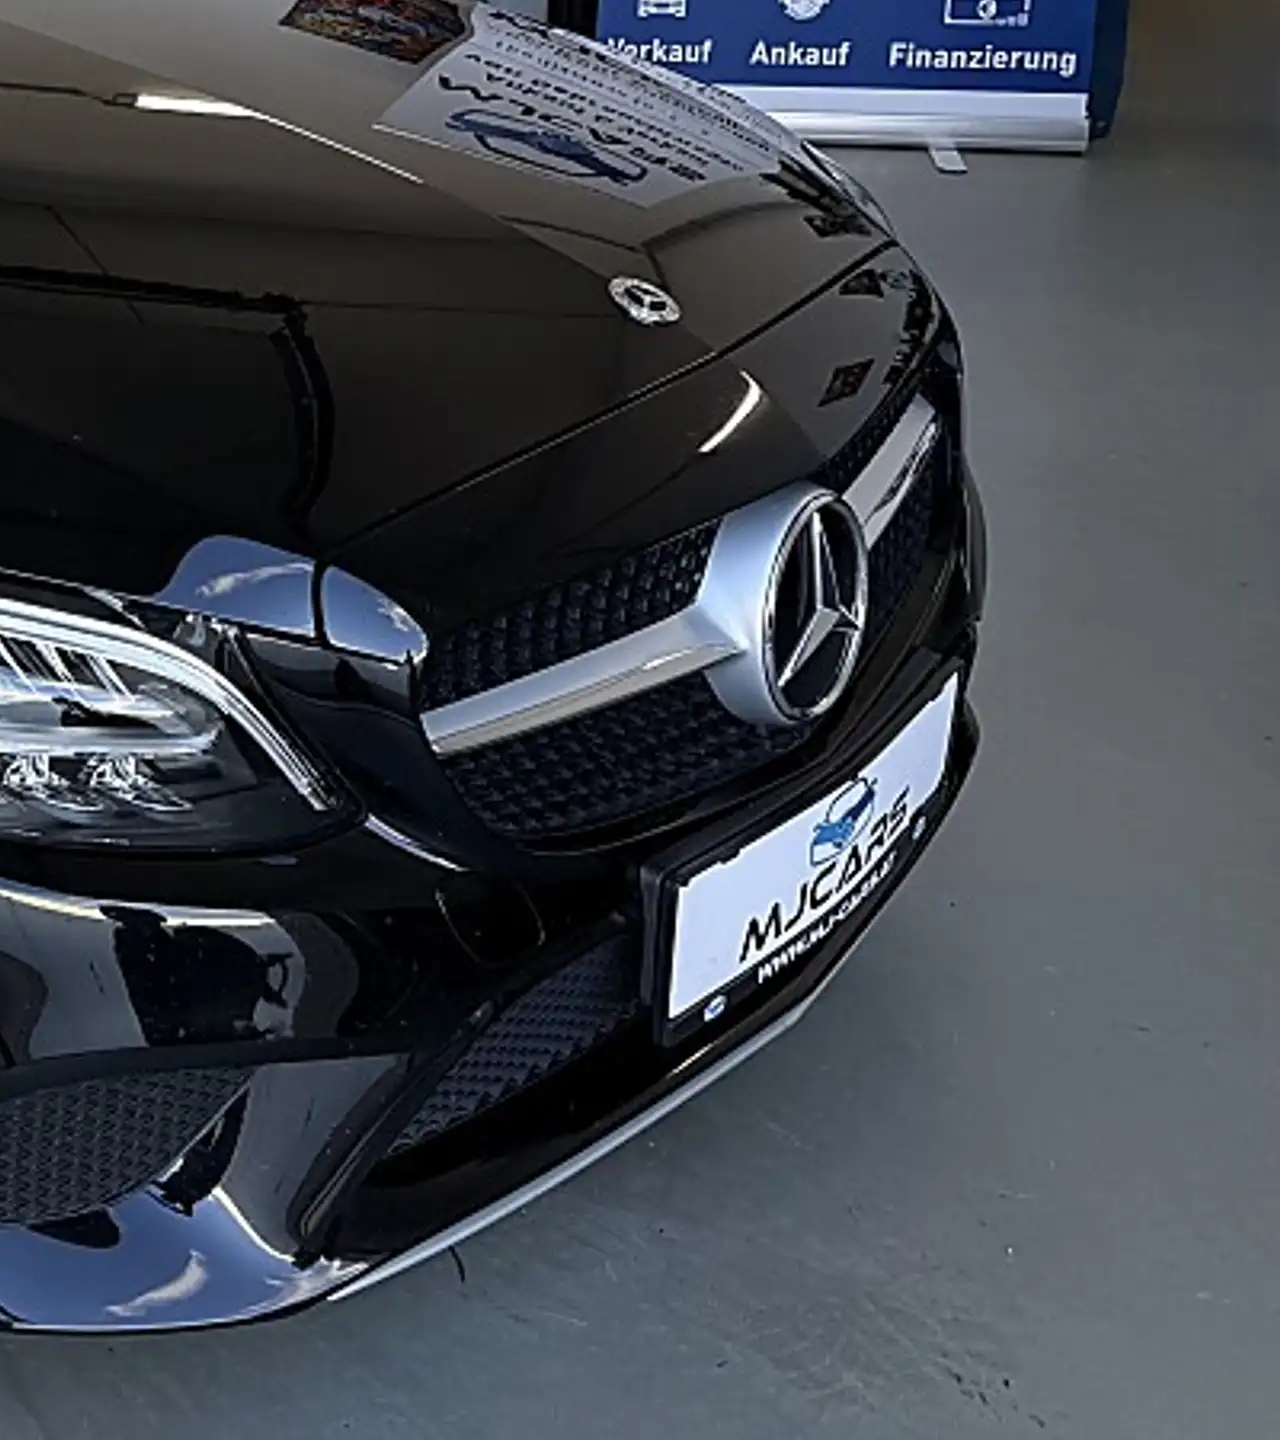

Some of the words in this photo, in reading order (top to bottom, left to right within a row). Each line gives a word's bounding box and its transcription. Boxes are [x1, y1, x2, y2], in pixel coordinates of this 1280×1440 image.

[607, 38, 711, 63] Verkauf
[750, 41, 850, 65] Ankauf
[890, 42, 1076, 76] Finanzierung
[740, 786, 909, 964] MJCARS
